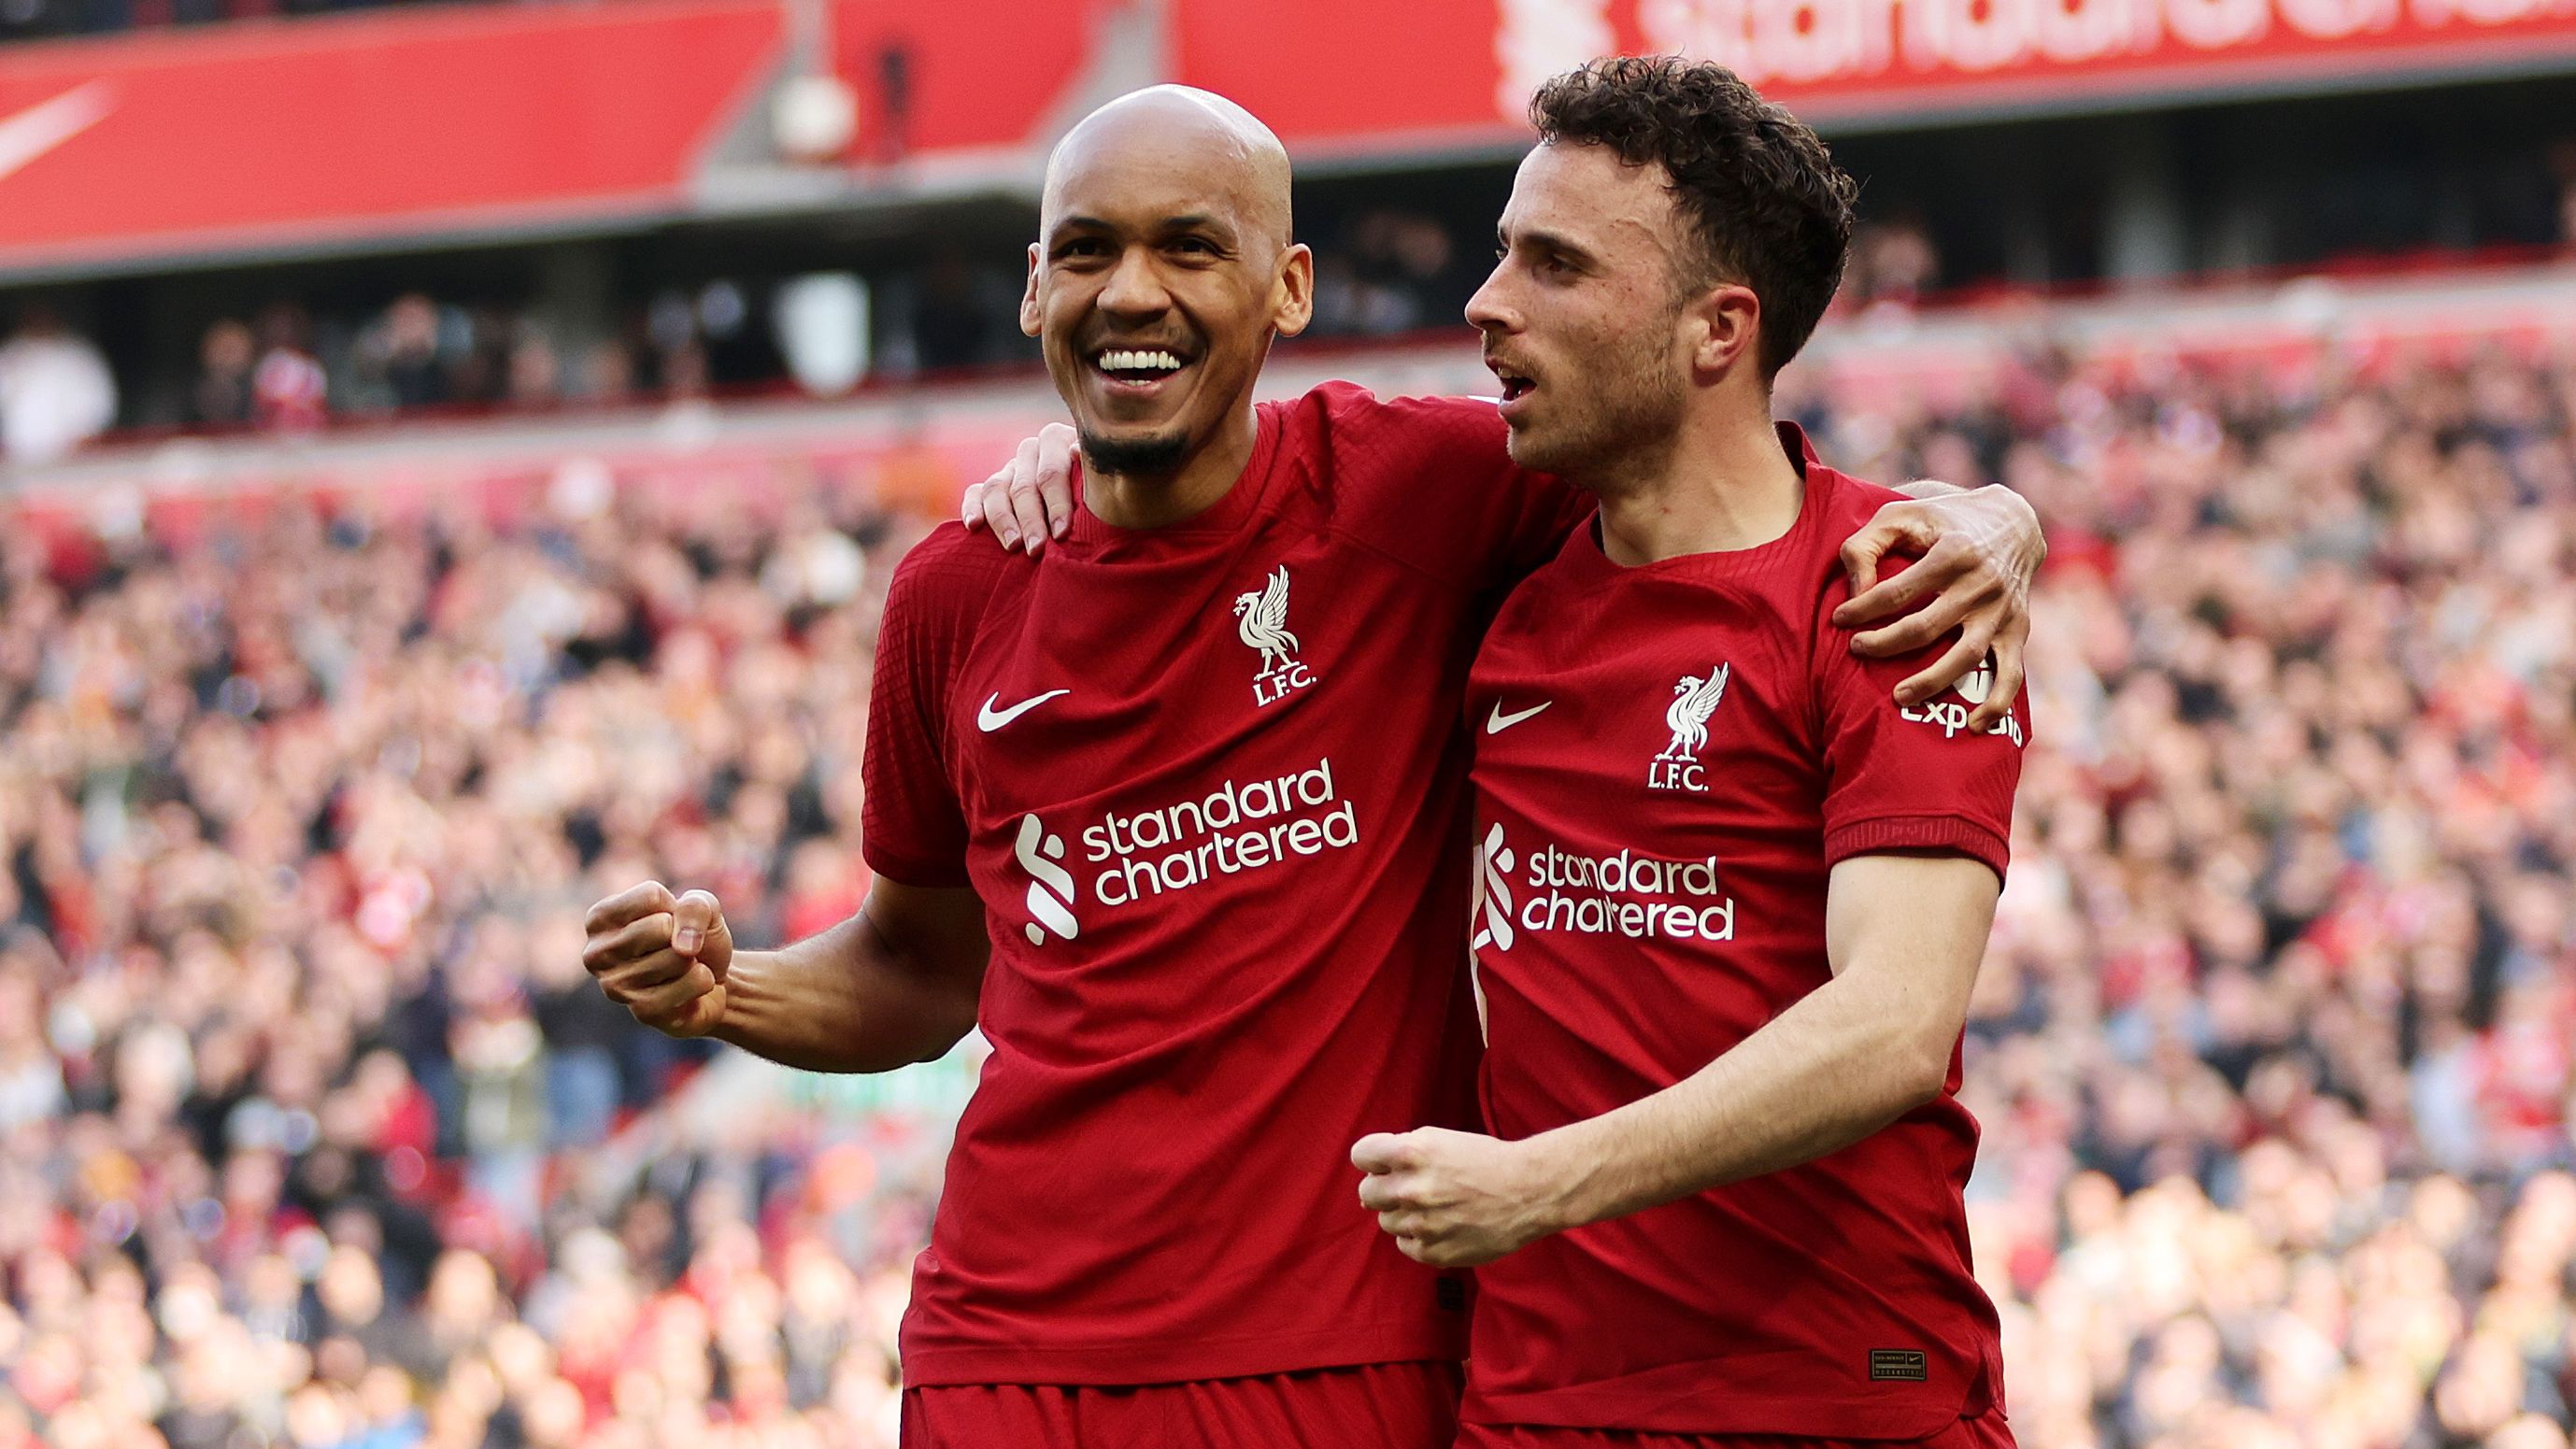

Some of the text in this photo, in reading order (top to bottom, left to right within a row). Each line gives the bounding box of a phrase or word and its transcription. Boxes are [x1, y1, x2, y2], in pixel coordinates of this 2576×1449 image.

[1252, 664, 1317, 707] L.F.C.
[1647, 761, 1709, 792] L.F.C.
[1082, 757, 1334, 862] standard
[1095, 800, 1359, 906] chartered
[1529, 843, 1717, 896] standard
